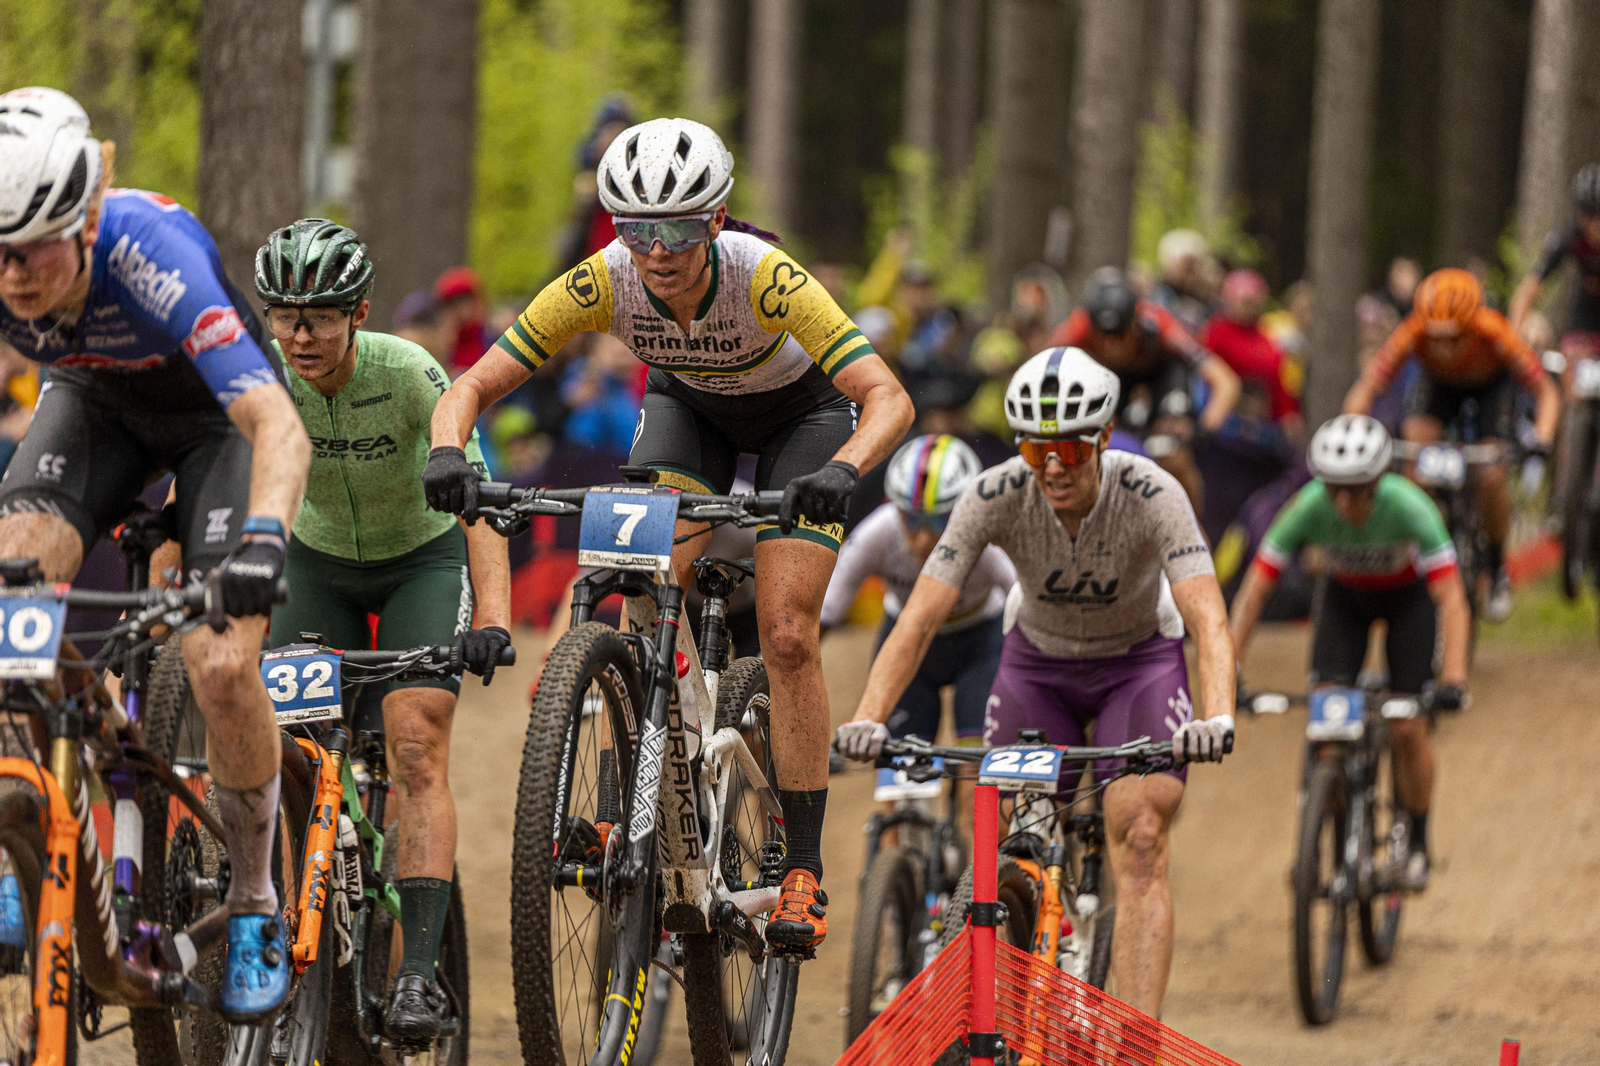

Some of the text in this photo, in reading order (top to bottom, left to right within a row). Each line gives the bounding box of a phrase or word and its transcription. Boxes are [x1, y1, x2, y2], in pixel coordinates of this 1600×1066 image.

[282, 296, 312, 305] MET
[632, 334, 742, 354] primaflor
[350, 391, 393, 410] SHIMANO
[311, 433, 397, 452] RBEA
[355, 445, 399, 462] TEAM
[612, 502, 648, 547] 7
[0, 606, 53, 653] 0
[267, 660, 335, 703] 32
[986, 750, 1057, 775] 22
